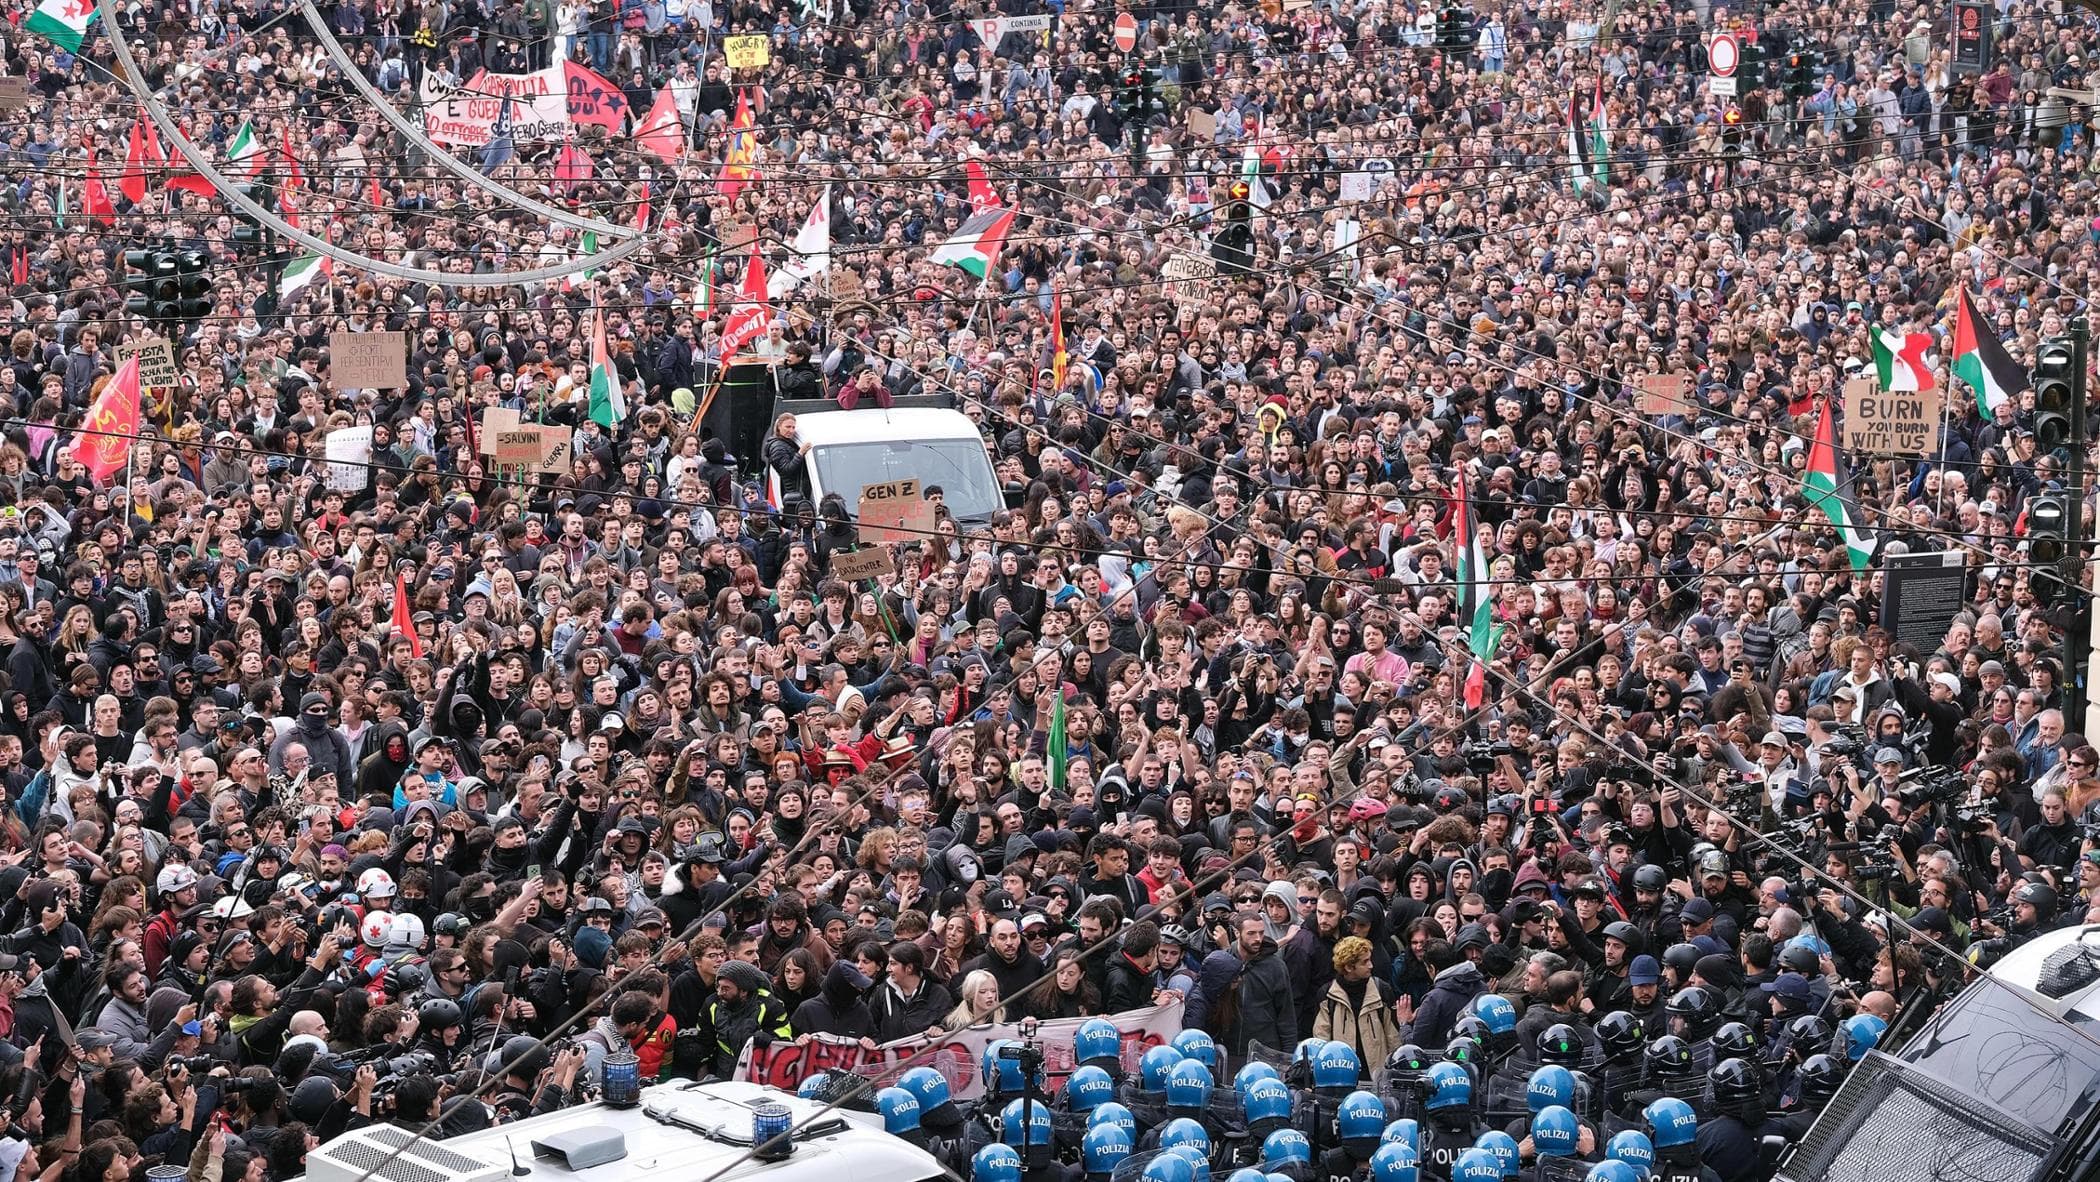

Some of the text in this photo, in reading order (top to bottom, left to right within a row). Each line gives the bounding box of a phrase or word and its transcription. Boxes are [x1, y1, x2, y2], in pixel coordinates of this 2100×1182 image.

[982, 20, 999, 42] R
[1010, 19, 1042, 29] CONTINUA
[729, 36, 767, 52] HUNGRY
[447, 98, 523, 122] E GUERA
[1859, 397, 1923, 420] BURN
[1894, 422, 1930, 434] BURN
[1850, 431, 1925, 450] WITH US
[542, 442, 568, 468] GUERRA
[865, 481, 915, 500] GEN Z
[838, 560, 884, 577] DATACENTER
[1085, 1029, 1118, 1042] POLIZIA
[1183, 1039, 1215, 1053] POLIZIA
[1321, 1059, 1355, 1071] POLIZIA
[1080, 1081, 1112, 1094] POLIZIA
[1172, 1078, 1205, 1089] POLIZIA
[1253, 1088, 1288, 1102] POLIZIA
[1527, 1084, 1557, 1098] POLIZIA
[1350, 1107, 1383, 1121] POLIZIA
[1536, 1129, 1570, 1141] POLIZIA
[1096, 1144, 1130, 1157] POLIZIA
[1618, 1147, 1651, 1160] POLIZIA
[1464, 1166, 1500, 1179] POLIZIA
